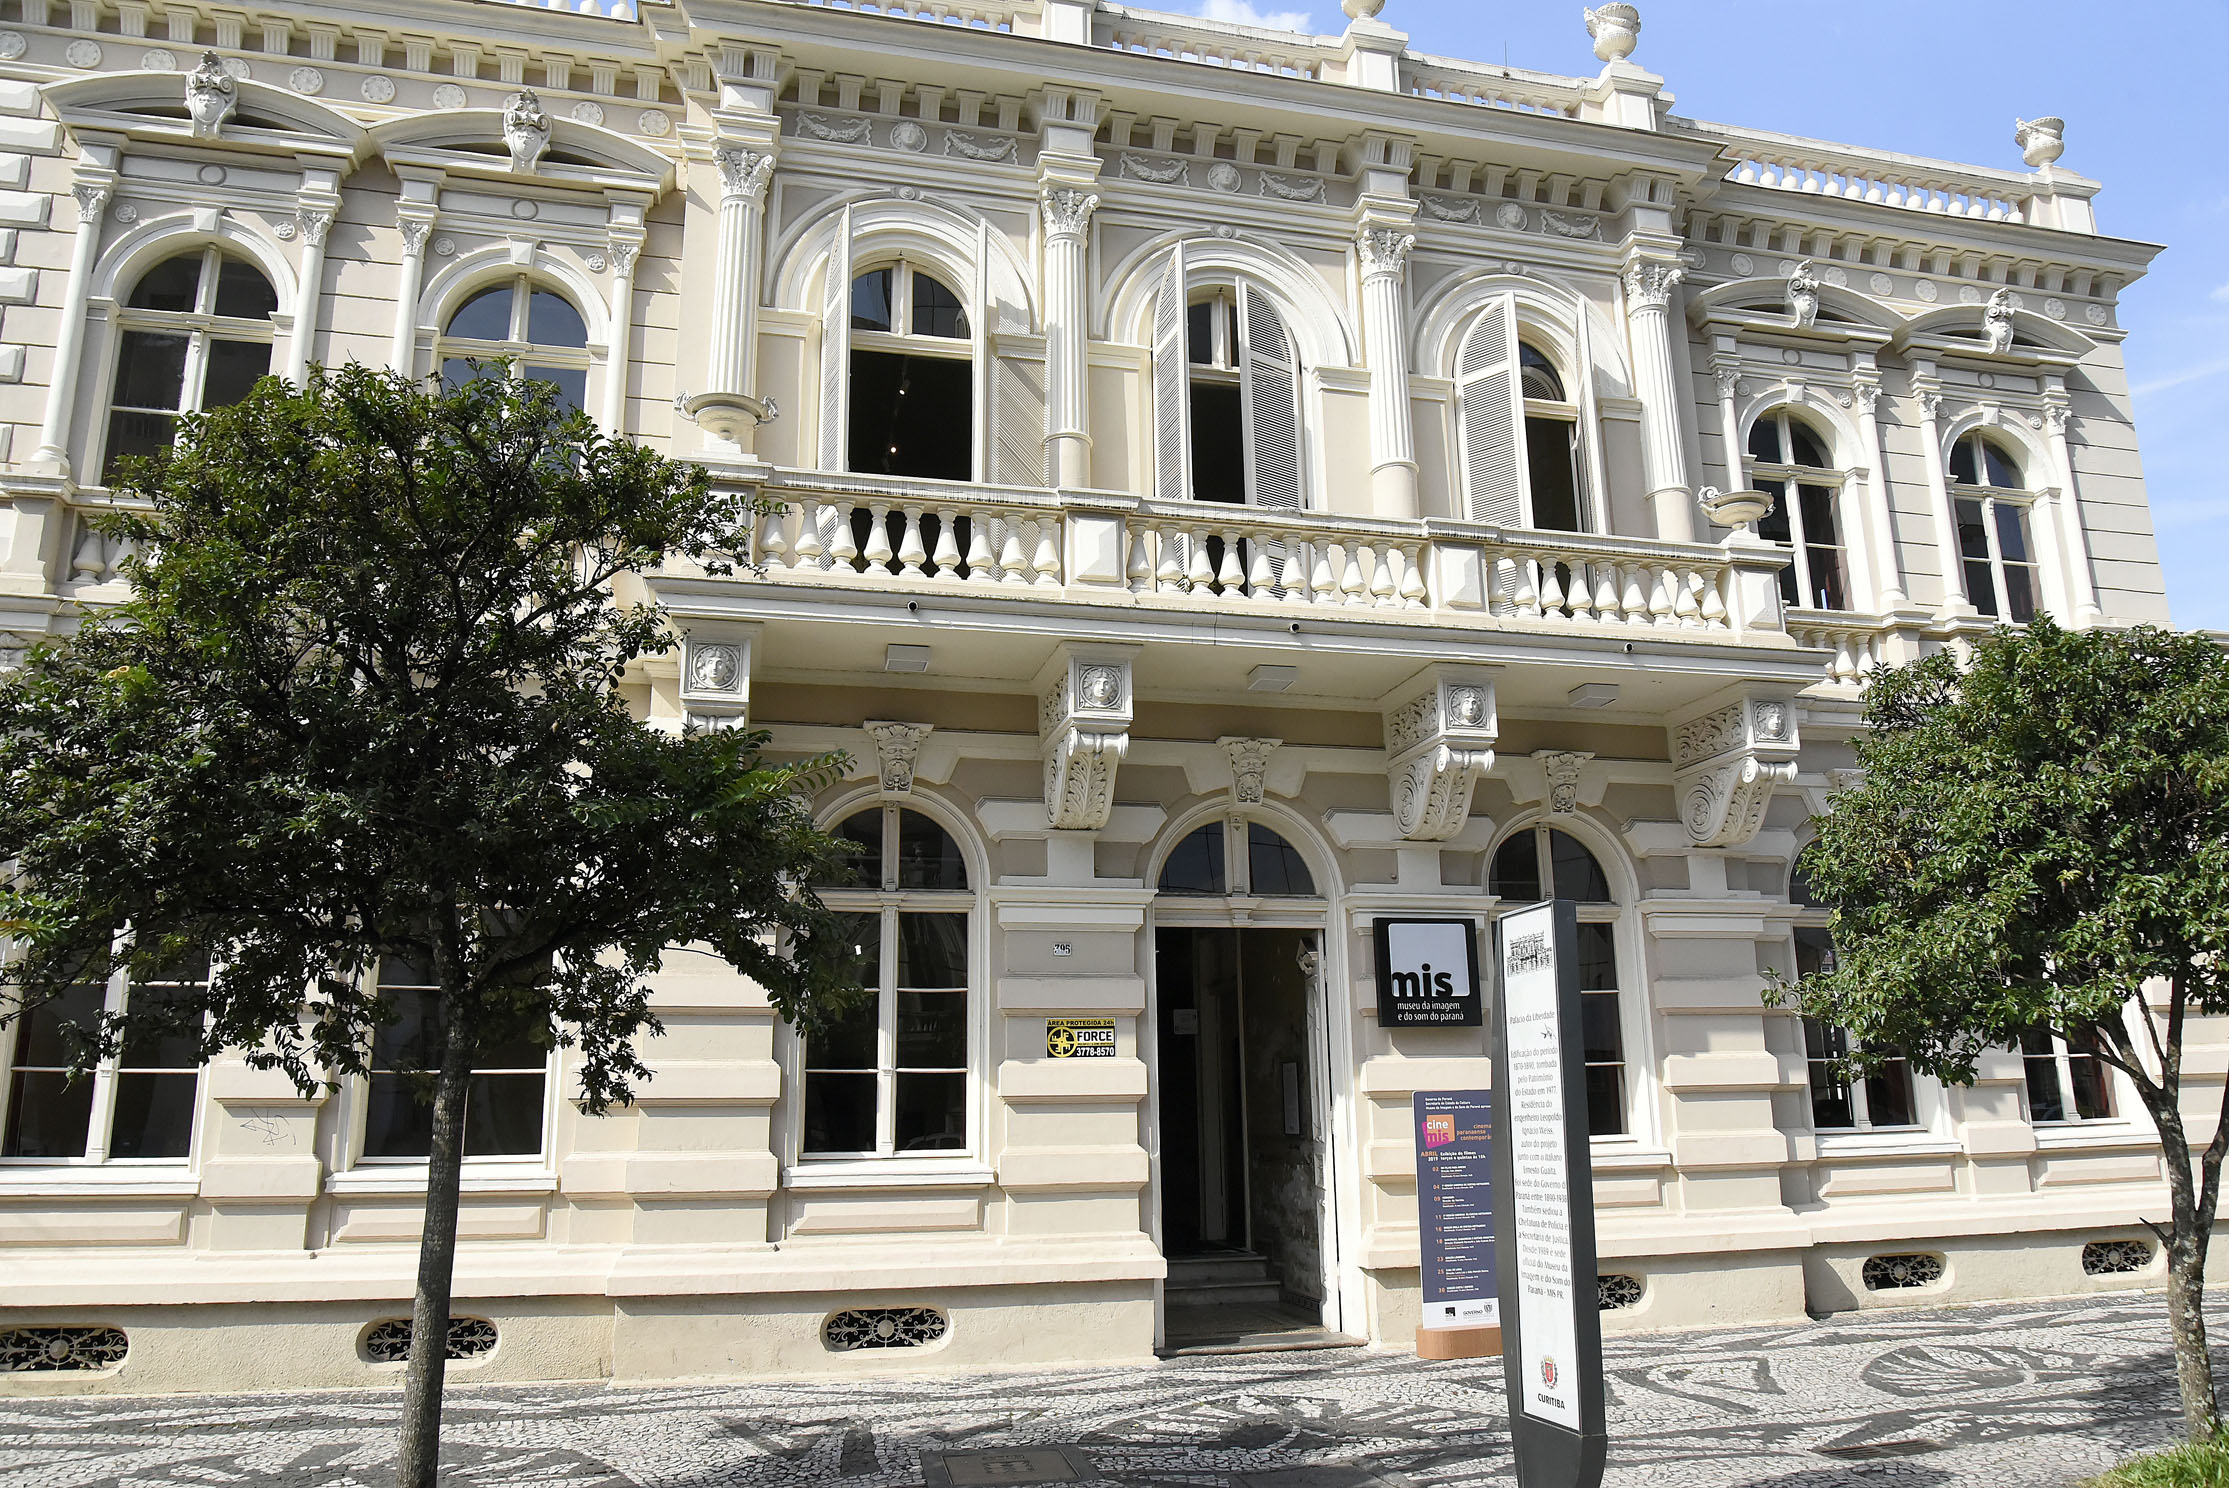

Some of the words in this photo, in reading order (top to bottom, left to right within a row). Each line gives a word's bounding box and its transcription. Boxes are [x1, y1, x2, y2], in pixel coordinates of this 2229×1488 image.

[1391, 963, 1453, 997] mis
[1397, 1002, 1420, 1010] museu
[1422, 1001, 1430, 1010] da
[1432, 1001, 1460, 1012] imagem
[1404, 1012, 1412, 1020] do
[1430, 1012, 1439, 1020] do
[1440, 1011, 1464, 1022] paraná
[1077, 1031, 1112, 1041] FORCE
[1076, 1047, 1114, 1056] 3778-8570
[1533, 1048, 1539, 1056] do
[1515, 1088, 1521, 1096] do
[1522, 1087, 1536, 1096] Estado
[1514, 1114, 1539, 1123] engenheiro
[1540, 1112, 1562, 1123] Leopoldo
[1427, 1120, 1448, 1129] cine
[1427, 1130, 1449, 1142] mis
[1521, 1140, 1532, 1148] autor
[1533, 1139, 1539, 1148] do
[1541, 1140, 1557, 1149] projeto
[1545, 1153, 1562, 1162] italiano
[1522, 1179, 1533, 1187] sede
[1534, 1179, 1539, 1187] do
[1541, 1180, 1561, 1188] Governo
[1516, 1191, 1530, 1200] Paraná
[1531, 1193, 1543, 1201] entre
[1542, 1207, 1558, 1216] sediou
[1541, 1220, 1547, 1228] de
[1545, 1234, 1551, 1242] de
[1555, 1250, 1566, 1258] sede
[1537, 1260, 1543, 1268] do
[1544, 1261, 1560, 1271] Museu
[1561, 1264, 1568, 1272] da
[1521, 1270, 1539, 1281] Imagem
[1545, 1274, 1551, 1283] do
[1552, 1275, 1563, 1285] Som
[1564, 1277, 1570, 1286] do
[1528, 1284, 1543, 1295] Paraná
[1538, 1393, 1565, 1410] CURITIBA
